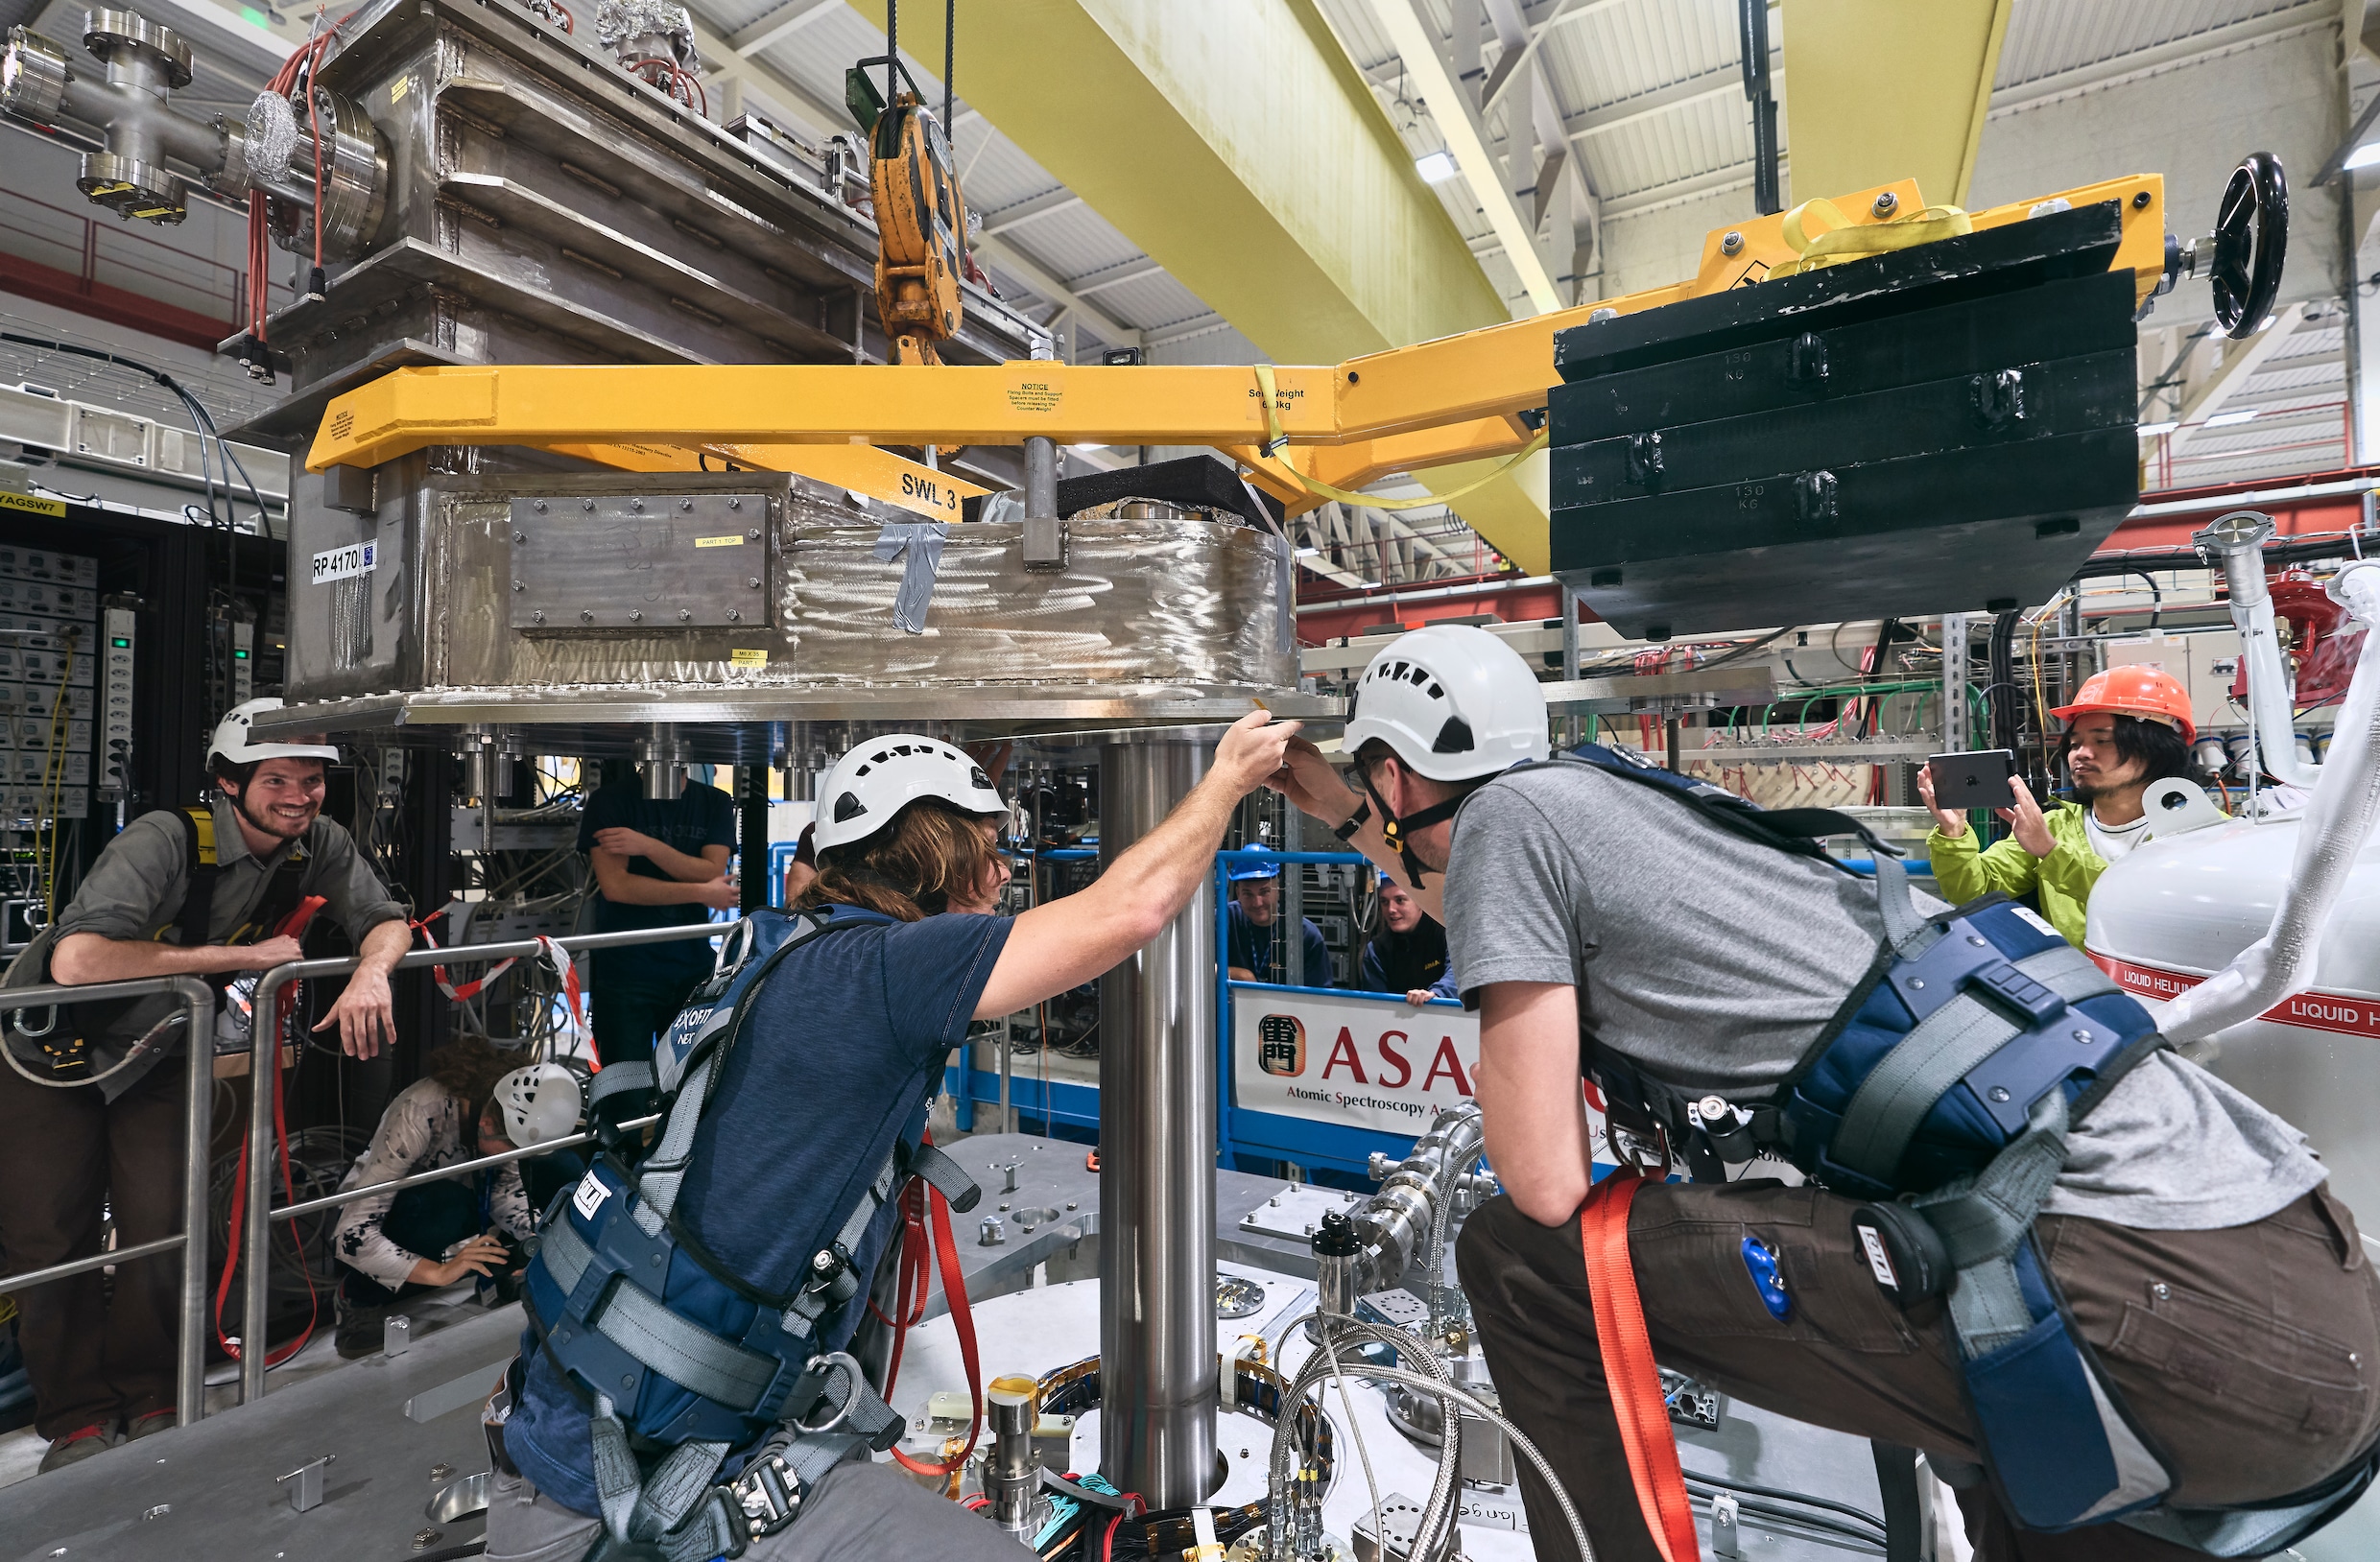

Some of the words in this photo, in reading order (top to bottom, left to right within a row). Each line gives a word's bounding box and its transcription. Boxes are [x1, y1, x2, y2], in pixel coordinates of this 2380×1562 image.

[902, 473, 942, 507] SWL
[947, 488, 956, 510] 3
[1735, 485, 1764, 498] 130
[1739, 498, 1758, 509] KG
[313, 556, 328, 578] RP
[330, 549, 358, 574] 4170
[2124, 970, 2152, 987] LIQUID
[2291, 1000, 2359, 1024] LIQUID
[1262, 1016, 1297, 1074] 雷門
[1321, 1026, 1474, 1097] ASA
[1287, 1085, 1332, 1103] Atomic
[1335, 1091, 1426, 1119] Spectroscopy
